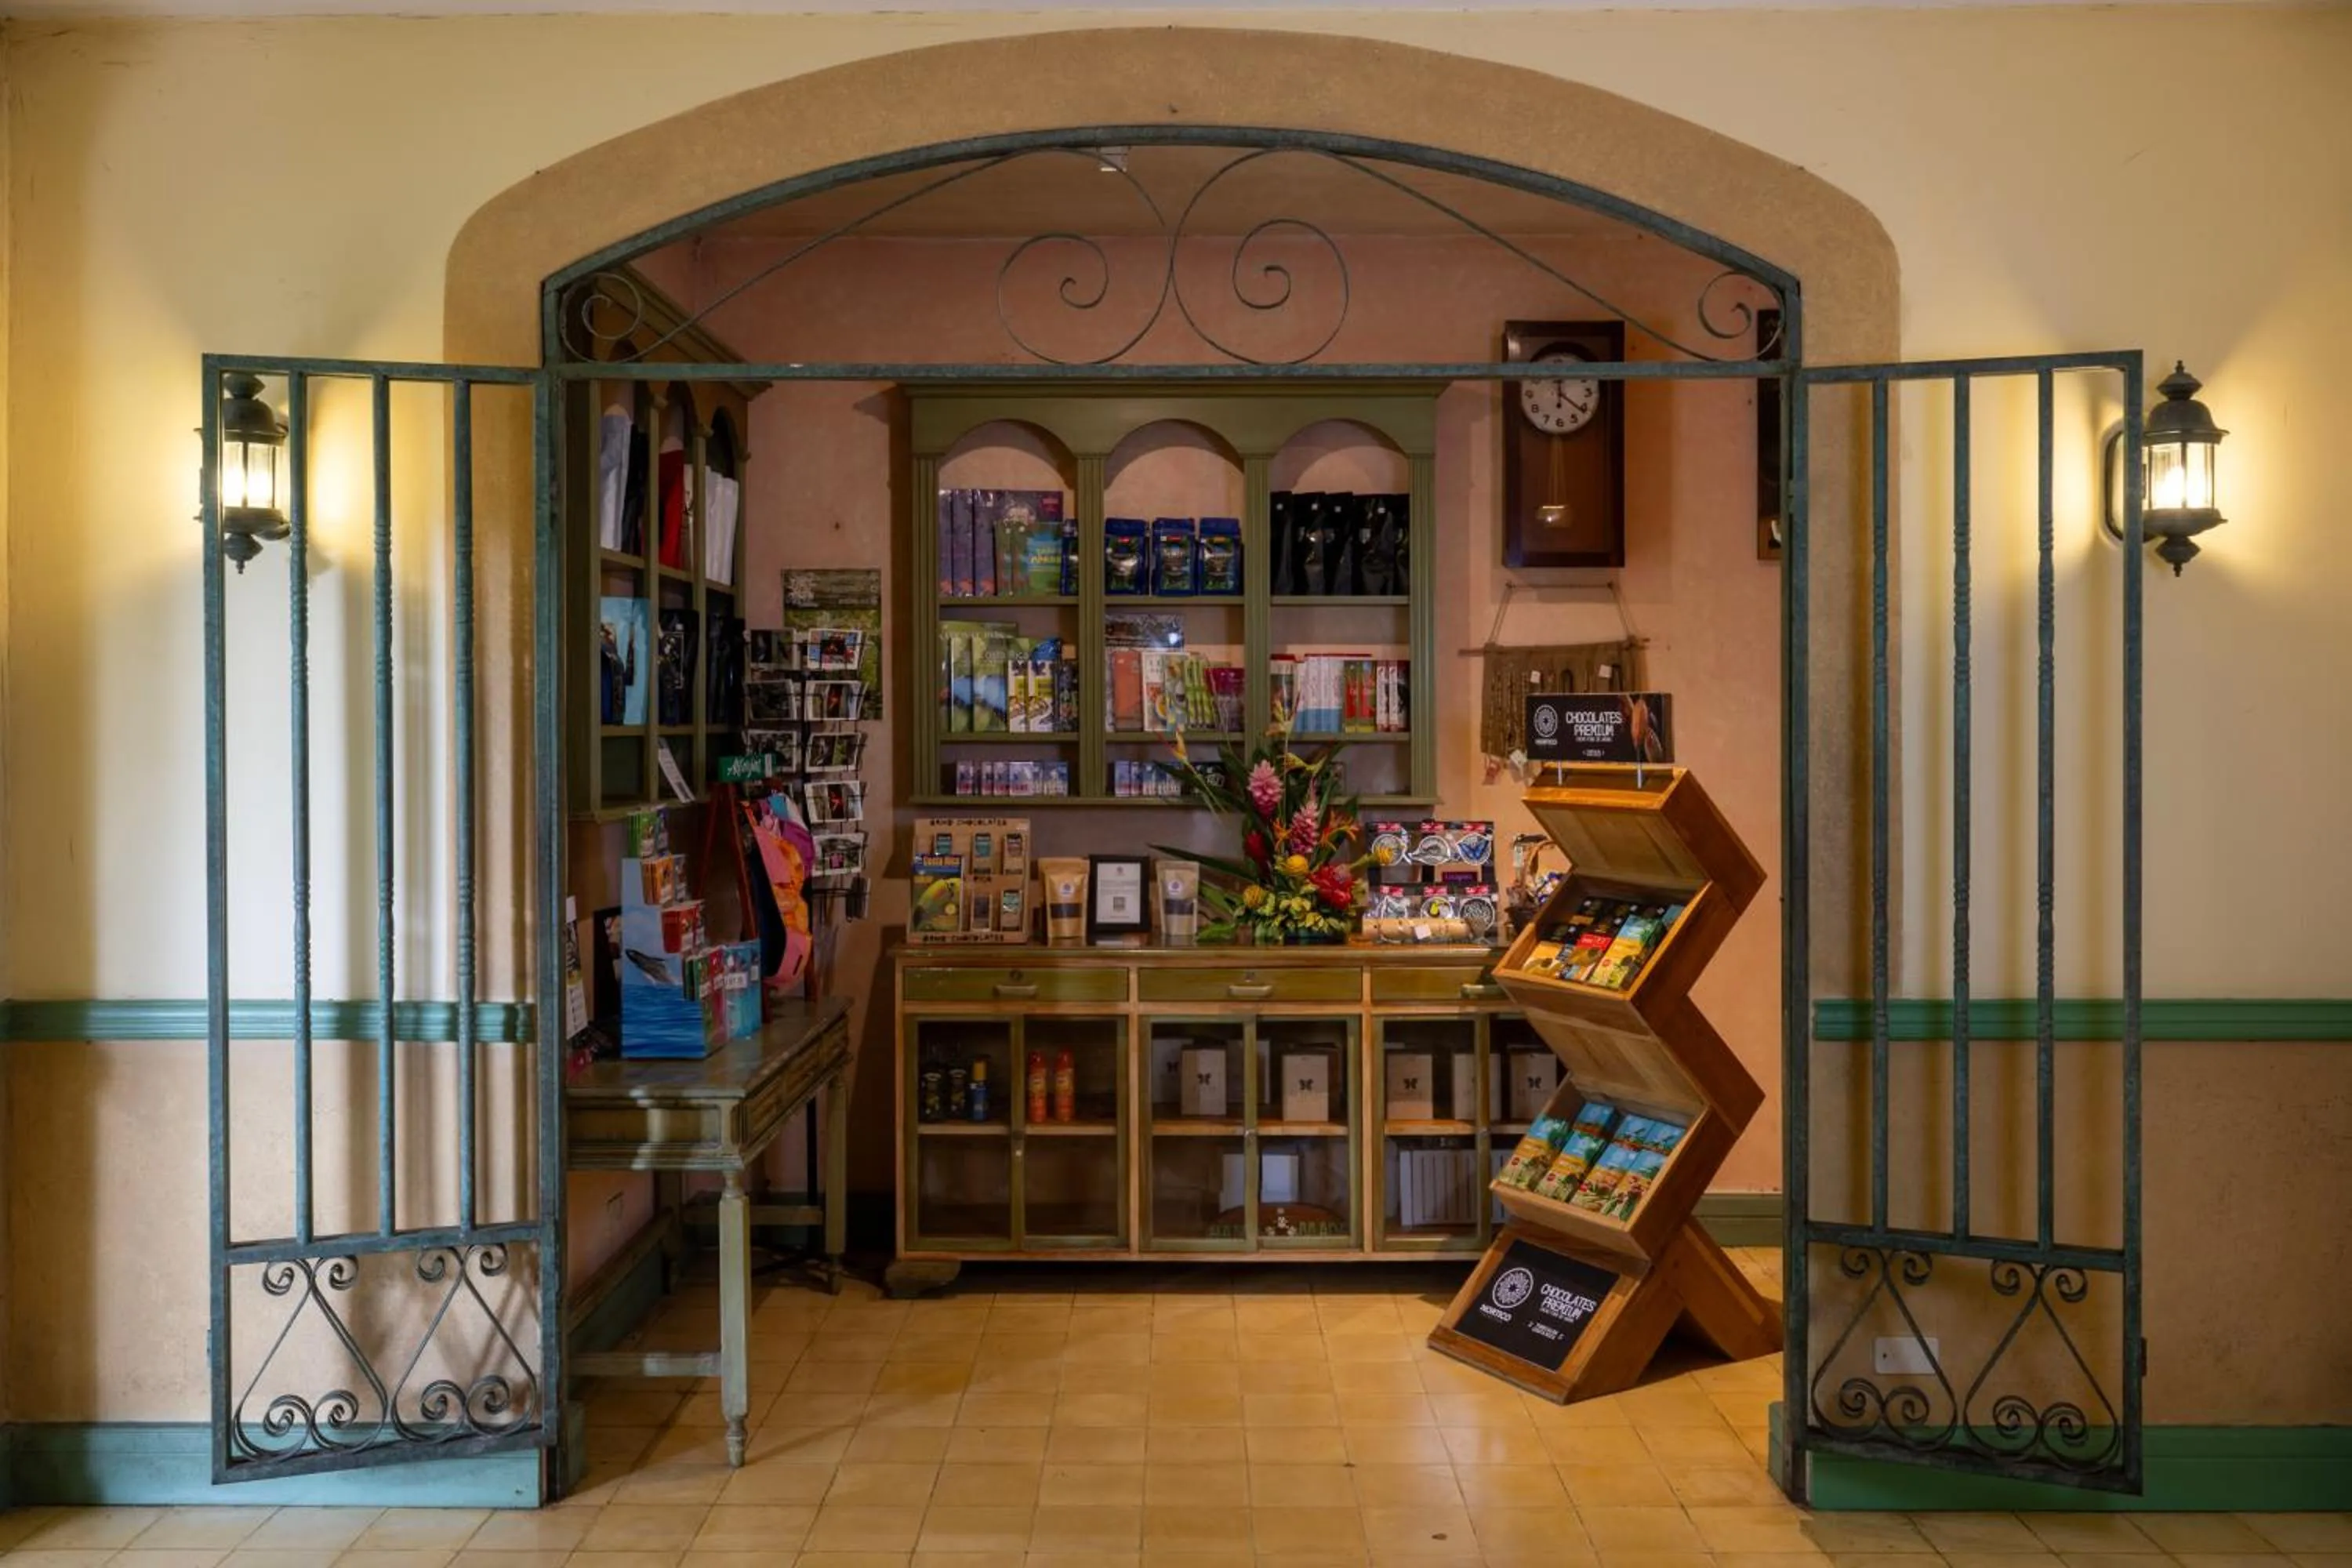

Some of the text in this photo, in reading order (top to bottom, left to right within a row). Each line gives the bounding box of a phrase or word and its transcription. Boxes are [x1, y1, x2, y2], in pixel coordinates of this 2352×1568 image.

[1584, 387, 1593, 397] 3
[1530, 404, 1539, 413] 8
[1542, 414, 1550, 424] 7
[1555, 418, 1565, 427] 6
[1569, 413, 1578, 423] 5
[1566, 711, 1623, 724] CHOCOLATES
[1574, 724, 1614, 736] PREMIUM
[1541, 1283, 1598, 1312] CHOCOLATES
[1541, 1296, 1583, 1320] PREMIUM
